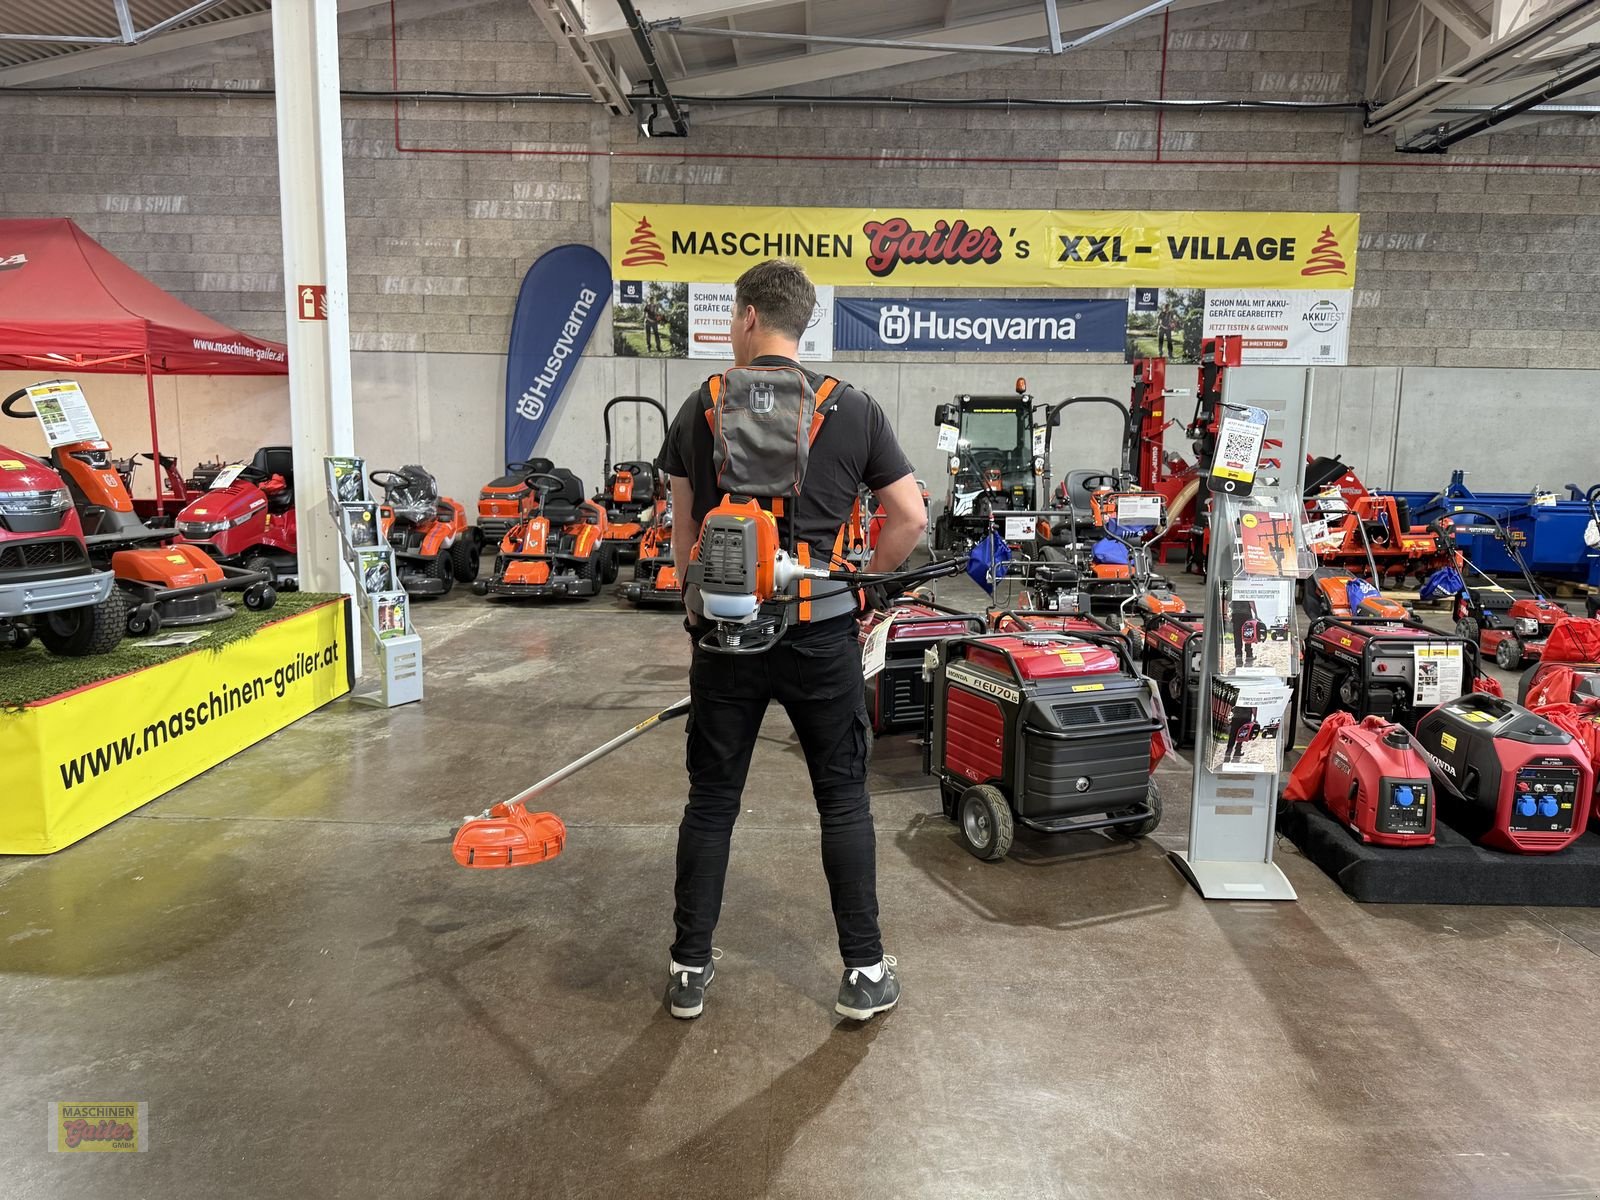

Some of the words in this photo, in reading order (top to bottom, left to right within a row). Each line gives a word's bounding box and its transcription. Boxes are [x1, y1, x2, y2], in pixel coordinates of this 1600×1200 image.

[672, 230, 852, 258] MASCHINEN
[863, 217, 1002, 277] Gailer
[1057, 235, 1128, 262] XXL
[1135, 245, 1152, 254] -
[1167, 236, 1296, 261] VILLAGE
[694, 294, 718, 302] SCHON
[719, 294, 734, 302] MAL
[1210, 299, 1234, 307] SCHON
[1266, 300, 1289, 308] AKKU-
[694, 303, 720, 312] GERÄTE
[1209, 308, 1235, 317] GERÄTE
[1237, 310, 1283, 318] GEARBEITET?
[1302, 312, 1345, 321] AKKUTEST
[914, 311, 1076, 344] Husqvarna
[193, 337, 285, 361] www.maschinen-gailer.at
[529, 287, 598, 399] Husqvarna
[948, 670, 968, 682] HONDA
[60, 640, 339, 790] www.maschinen-gailer.at
